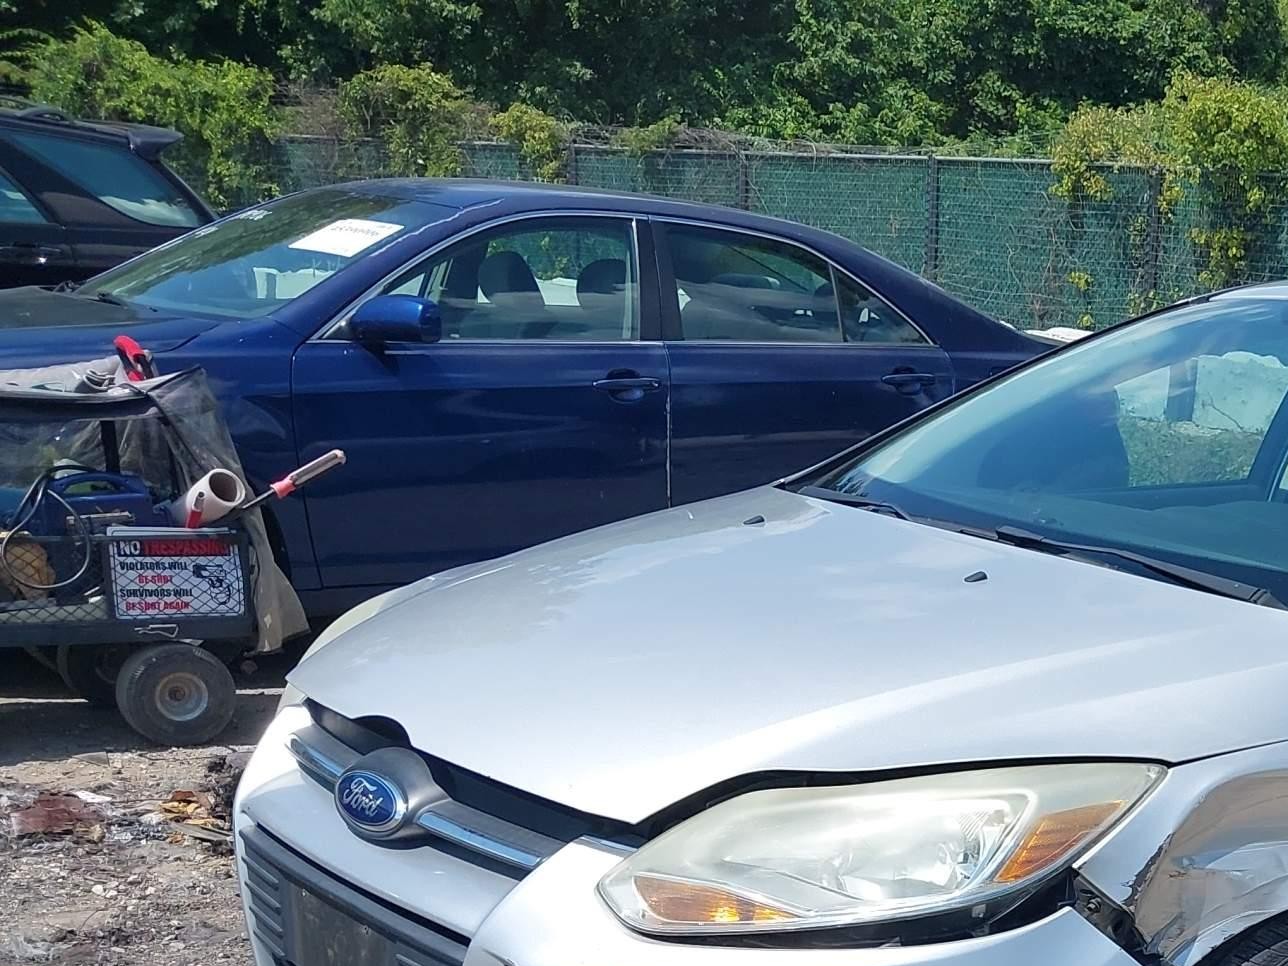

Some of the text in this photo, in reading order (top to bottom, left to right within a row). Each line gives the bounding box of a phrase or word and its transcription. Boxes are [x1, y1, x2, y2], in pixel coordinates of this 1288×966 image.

[119, 540, 141, 555] NO
[119, 562, 189, 571] VIOLATORS WILL
[119, 588, 194, 598] SURVIVORS WILL
[343, 777, 384, 817] Ford
